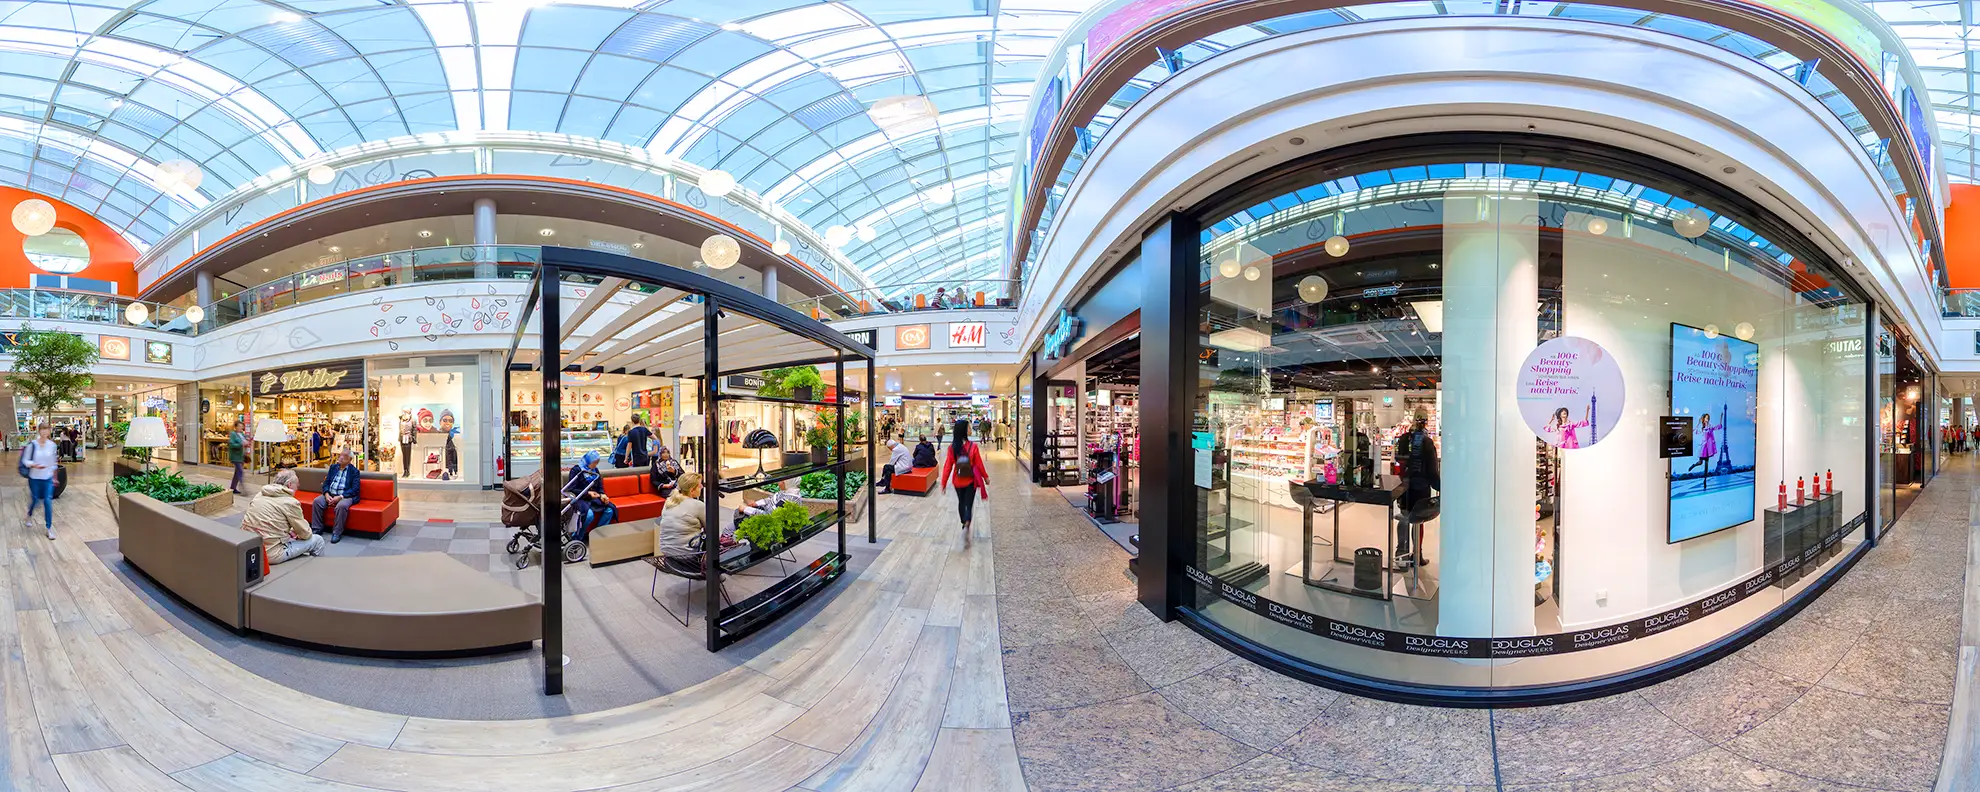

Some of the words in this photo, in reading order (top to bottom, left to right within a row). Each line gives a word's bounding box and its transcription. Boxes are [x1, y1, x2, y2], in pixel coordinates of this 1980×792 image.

[952, 324, 983, 345] H&M
[1540, 358, 1572, 367] Beauty-
[1702, 350, 1716, 360] 100
[1530, 365, 1572, 375] Shopping
[1686, 356, 1754, 378] Beauty-Shopping
[280, 368, 348, 391] Tchibo
[744, 378, 766, 388] BONITA
[1676, 372, 1702, 383] Reise
[1704, 377, 1724, 387] nach
[1530, 386, 1552, 394] nach
[1779, 556, 1800, 572] DOUGLAS
[1186, 565, 1213, 584] DOUGLAS
[1746, 570, 1772, 590] DOUGLAS
[1222, 583, 1256, 604] DOUGLAS
[1702, 588, 1736, 608] DOUGLAS
[1269, 603, 1314, 624] DOUGLAS
[1645, 608, 1690, 628] DOUGLAS
[1330, 622, 1385, 640] DOUGLAS
[1330, 631, 1362, 642] Designer
[1362, 638, 1385, 646] WEEKS
[1574, 625, 1629, 642] DOUGLAS
[1406, 636, 1468, 648] DOUGLAS
[1492, 638, 1554, 650] DOUGLAS
[1574, 639, 1608, 648] Designer
[1608, 634, 1629, 643] WEEKS
[1406, 646, 1441, 655] Designer
[1492, 648, 1528, 656] Designer
